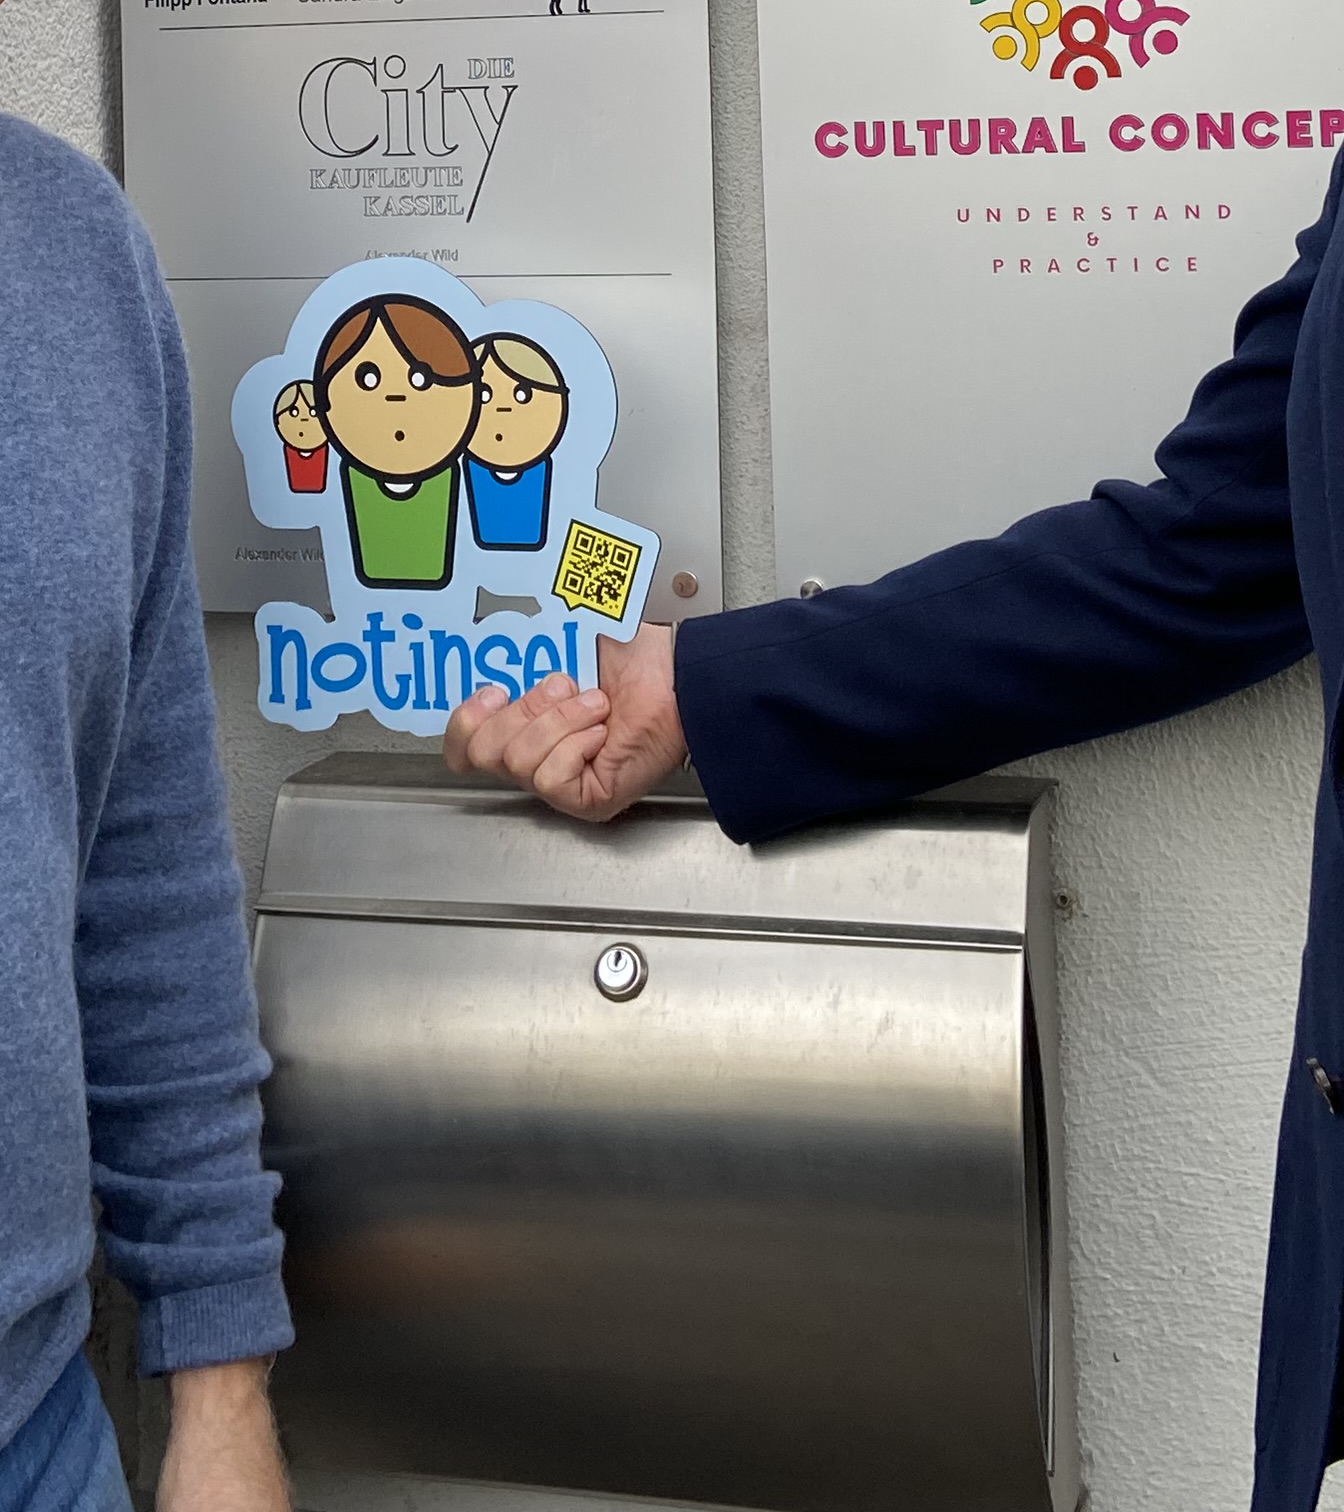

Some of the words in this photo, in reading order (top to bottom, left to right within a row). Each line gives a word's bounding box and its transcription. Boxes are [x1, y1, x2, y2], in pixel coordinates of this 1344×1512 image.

[467, 58, 514, 79] DIE
[299, 54, 519, 223] City
[815, 116, 1085, 158] CULTURAL
[309, 166, 463, 189] KAUFLEUTE
[363, 195, 464, 217] KASSEL
[958, 205, 1230, 222] UNDERSTAND
[1087, 232, 1099, 246] &
[432, 249, 458, 261] Wild
[993, 257, 1197, 273] PRACTICE
[235, 547, 297, 560] Alexander
[267, 612, 579, 710] notinsel
